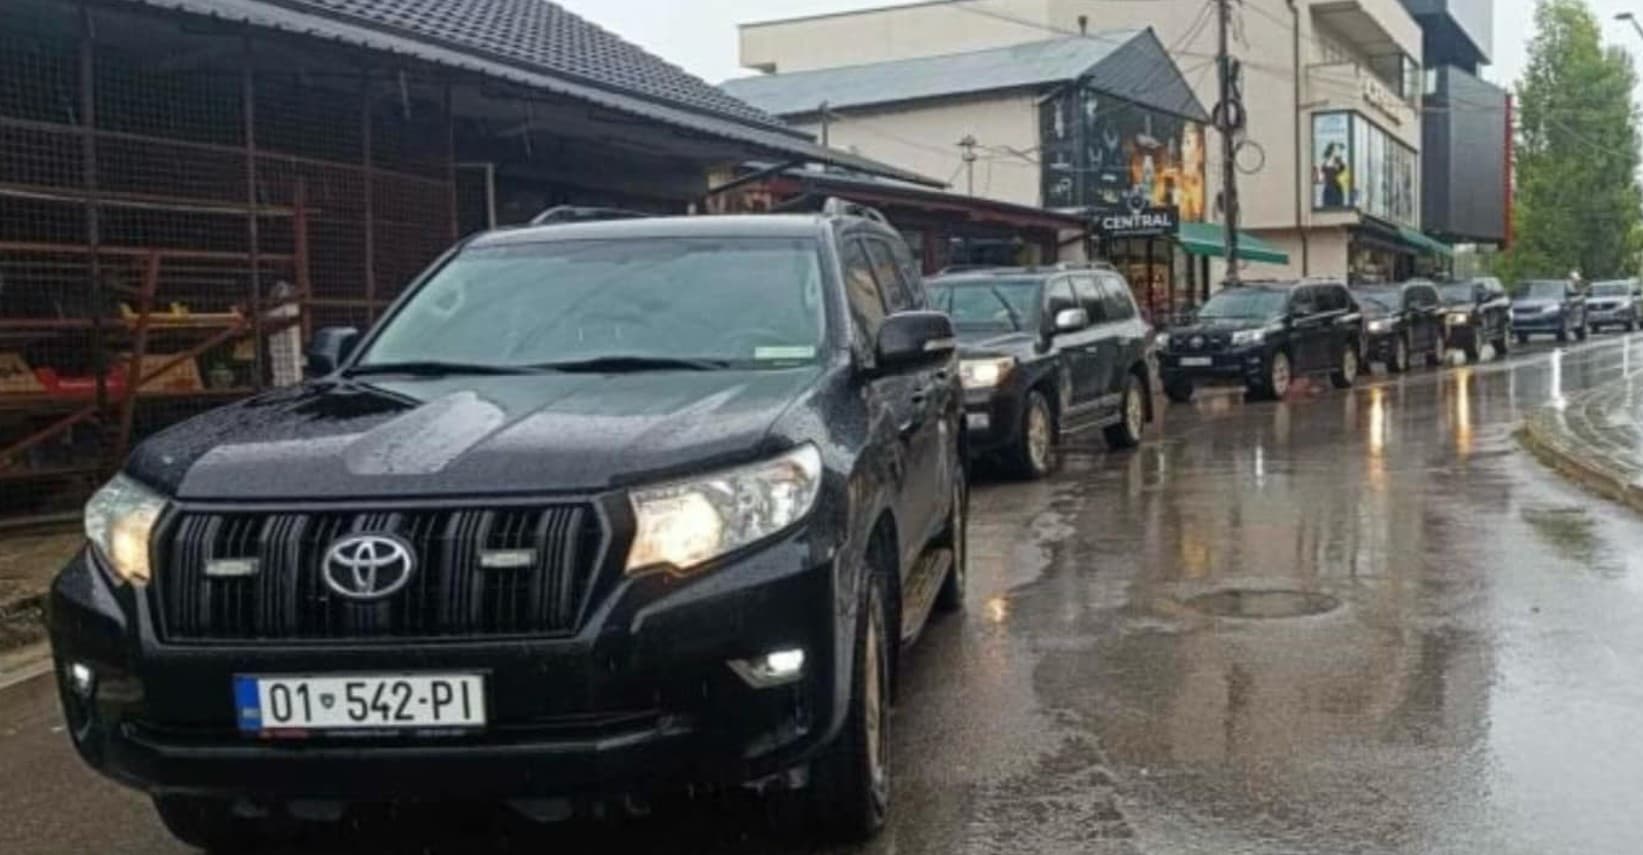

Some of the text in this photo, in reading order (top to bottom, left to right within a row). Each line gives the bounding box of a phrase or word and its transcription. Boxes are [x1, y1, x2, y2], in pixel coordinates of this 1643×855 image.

[1102, 212, 1172, 230] CENTRAL
[269, 680, 471, 723] 01 542-PI
